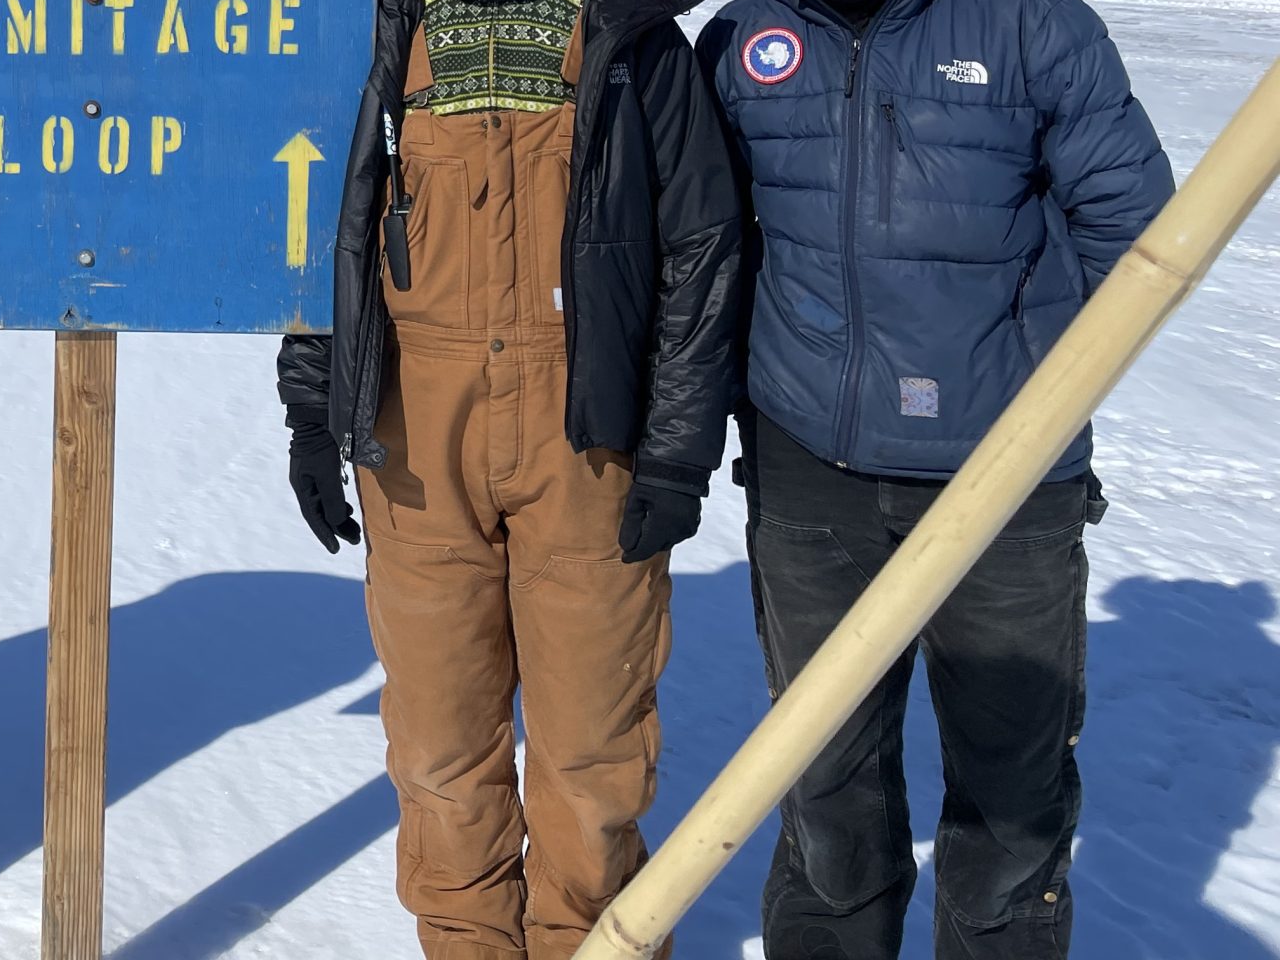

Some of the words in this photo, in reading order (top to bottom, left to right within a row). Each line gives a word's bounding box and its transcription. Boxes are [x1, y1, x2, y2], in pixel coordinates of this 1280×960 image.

[952, 59, 972, 69] THE
[937, 64, 971, 76] NORTH
[946, 73, 971, 83] FACE
